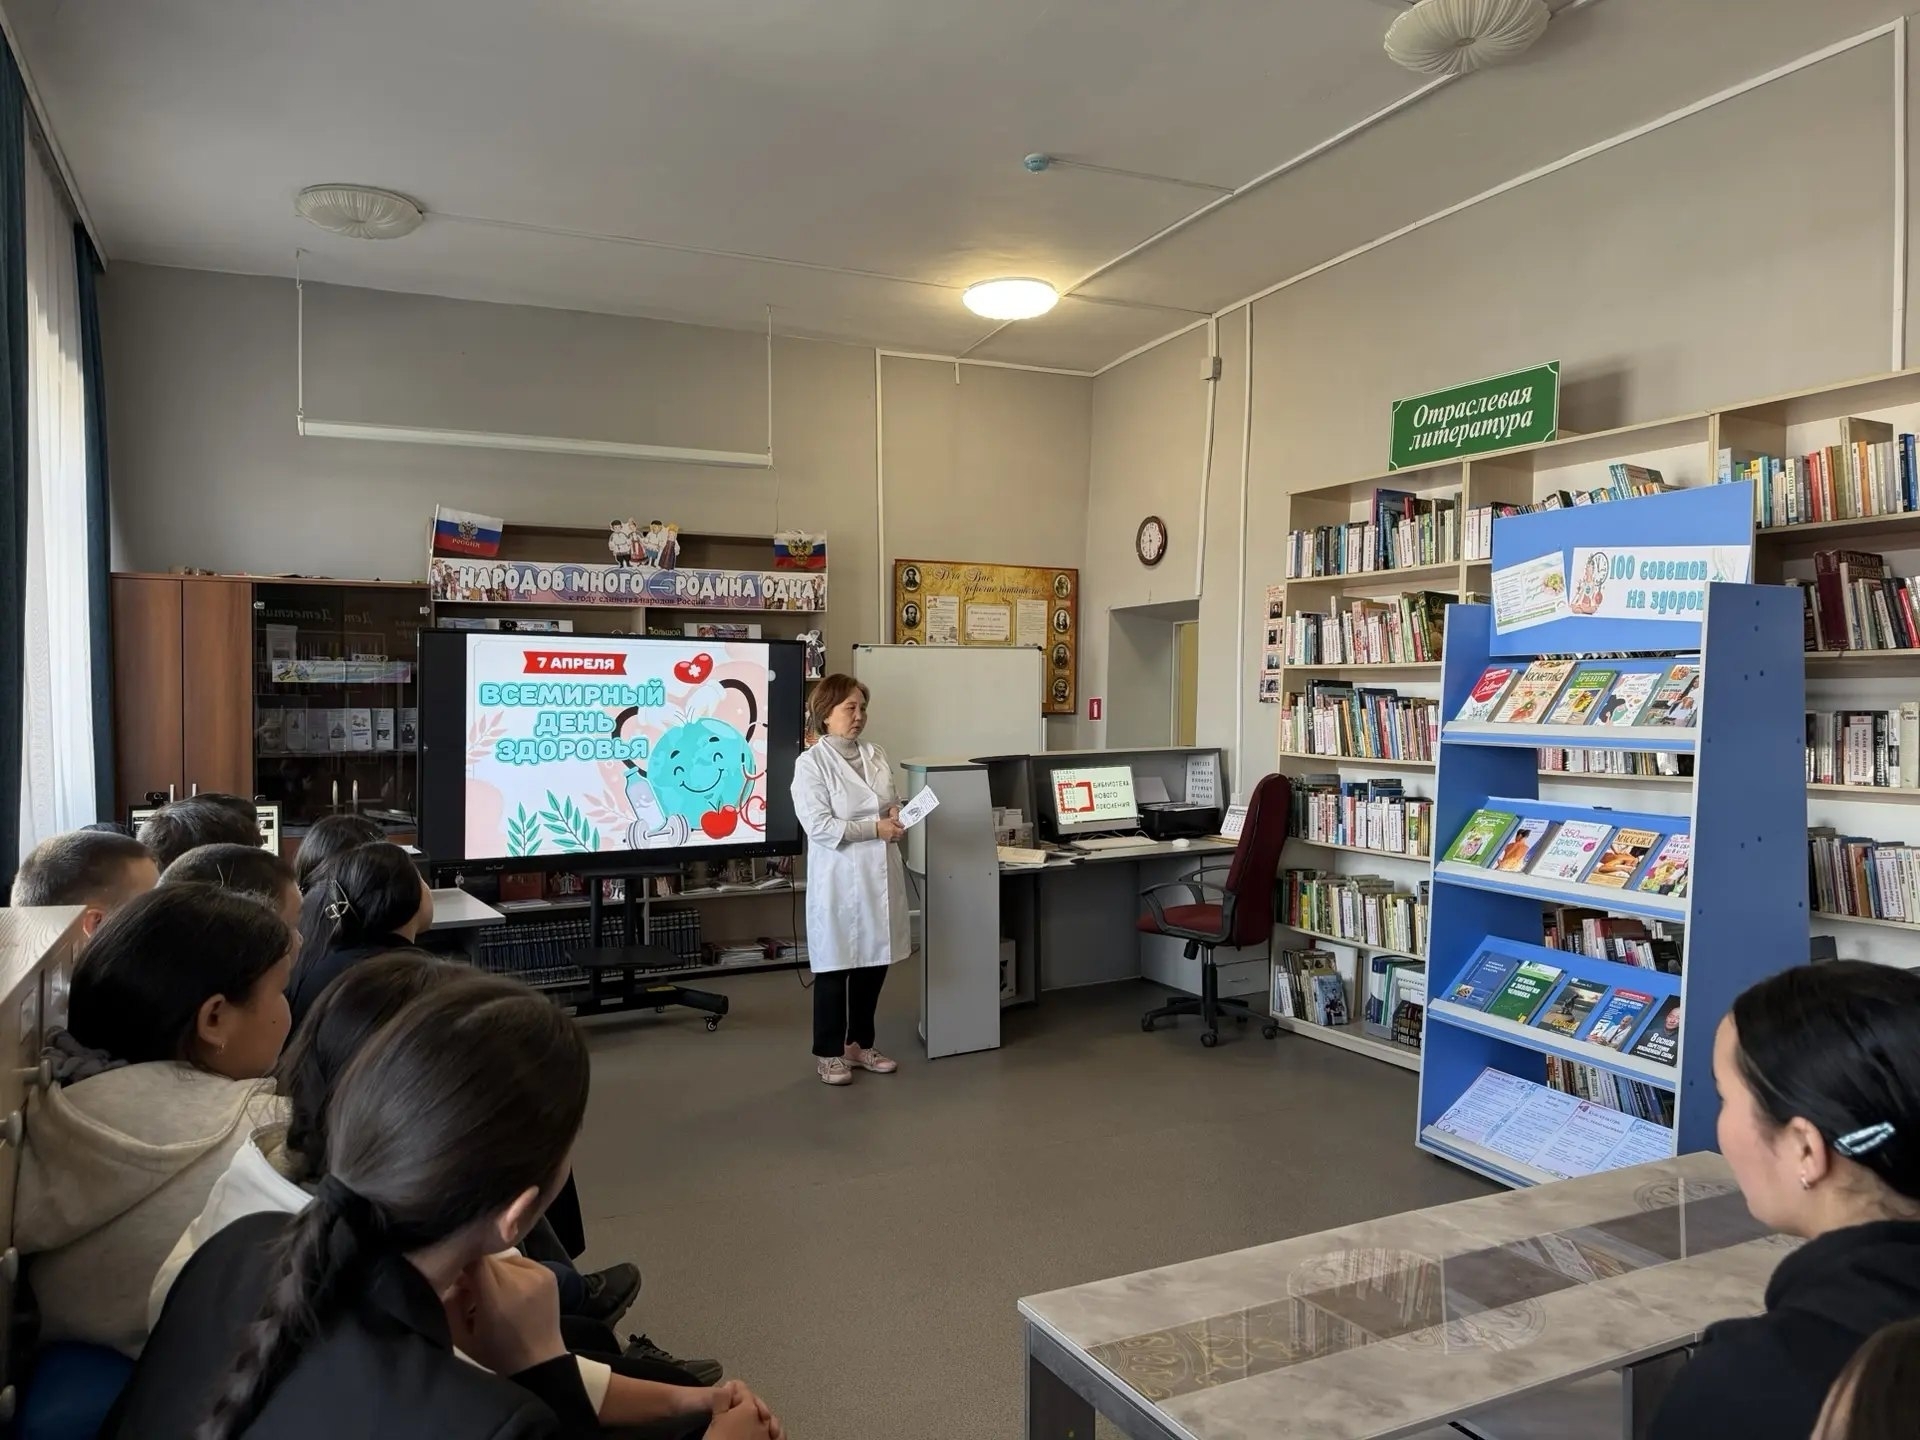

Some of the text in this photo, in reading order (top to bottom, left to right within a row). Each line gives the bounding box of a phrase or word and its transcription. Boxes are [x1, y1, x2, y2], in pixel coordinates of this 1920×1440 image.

[1413, 386, 1533, 428] Отраслевая
[1408, 410, 1534, 451] литература
[452, 538, 480, 549] РОССИЯ
[1609, 555, 1708, 581] 100 советов
[458, 565, 566, 595] НАРОДОВ
[572, 570, 645, 595] МНОГО
[675, 574, 757, 601] РОДИНА
[762, 577, 815, 603] ОДНА
[576, 596, 597, 604] году
[1626, 588, 1646, 609] на
[536, 657, 616, 670] 7 АПРЕЛЯ
[480, 680, 665, 706] ВСЕМИРНЫЙ
[535, 711, 616, 737] ДЕНЬ
[496, 738, 650, 765] ЗДОРОВЬЯ
[1561, 828, 1581, 839] 350
[1650, 1032, 1659, 1042] 8
